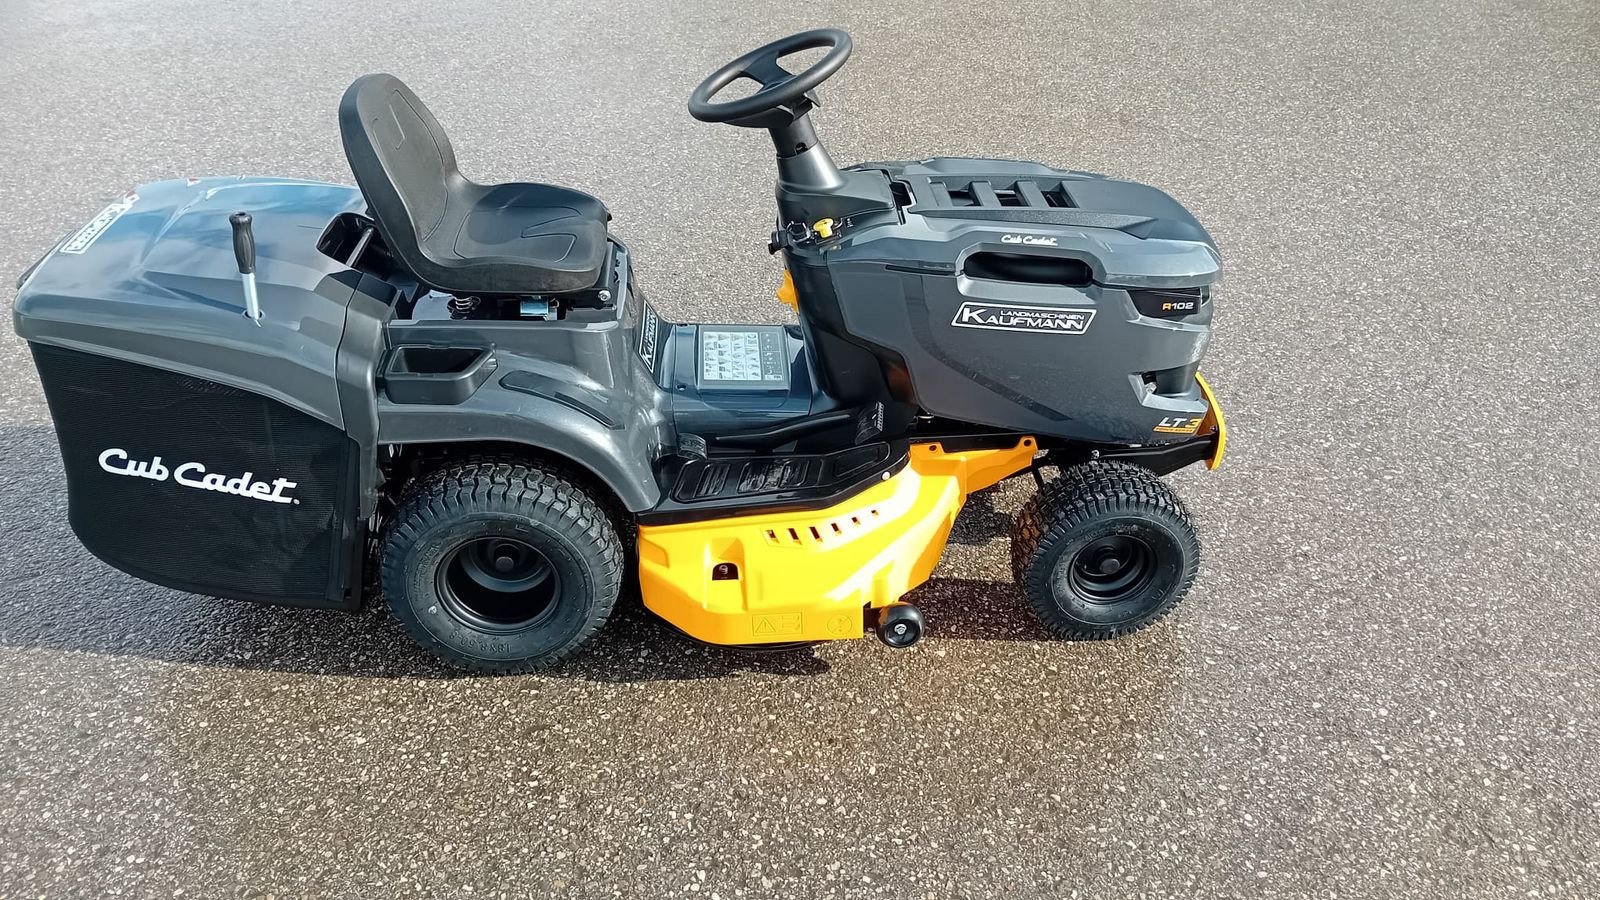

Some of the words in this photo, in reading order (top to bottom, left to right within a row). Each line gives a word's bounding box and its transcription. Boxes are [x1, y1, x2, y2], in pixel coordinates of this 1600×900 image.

[1001, 234, 1023, 245] Cub
[1023, 235, 1059, 246] Cadet
[962, 307, 1085, 330] KAUFMANN
[1000, 310, 1085, 320] LANDMASCHINEN
[98, 447, 170, 482] Cub
